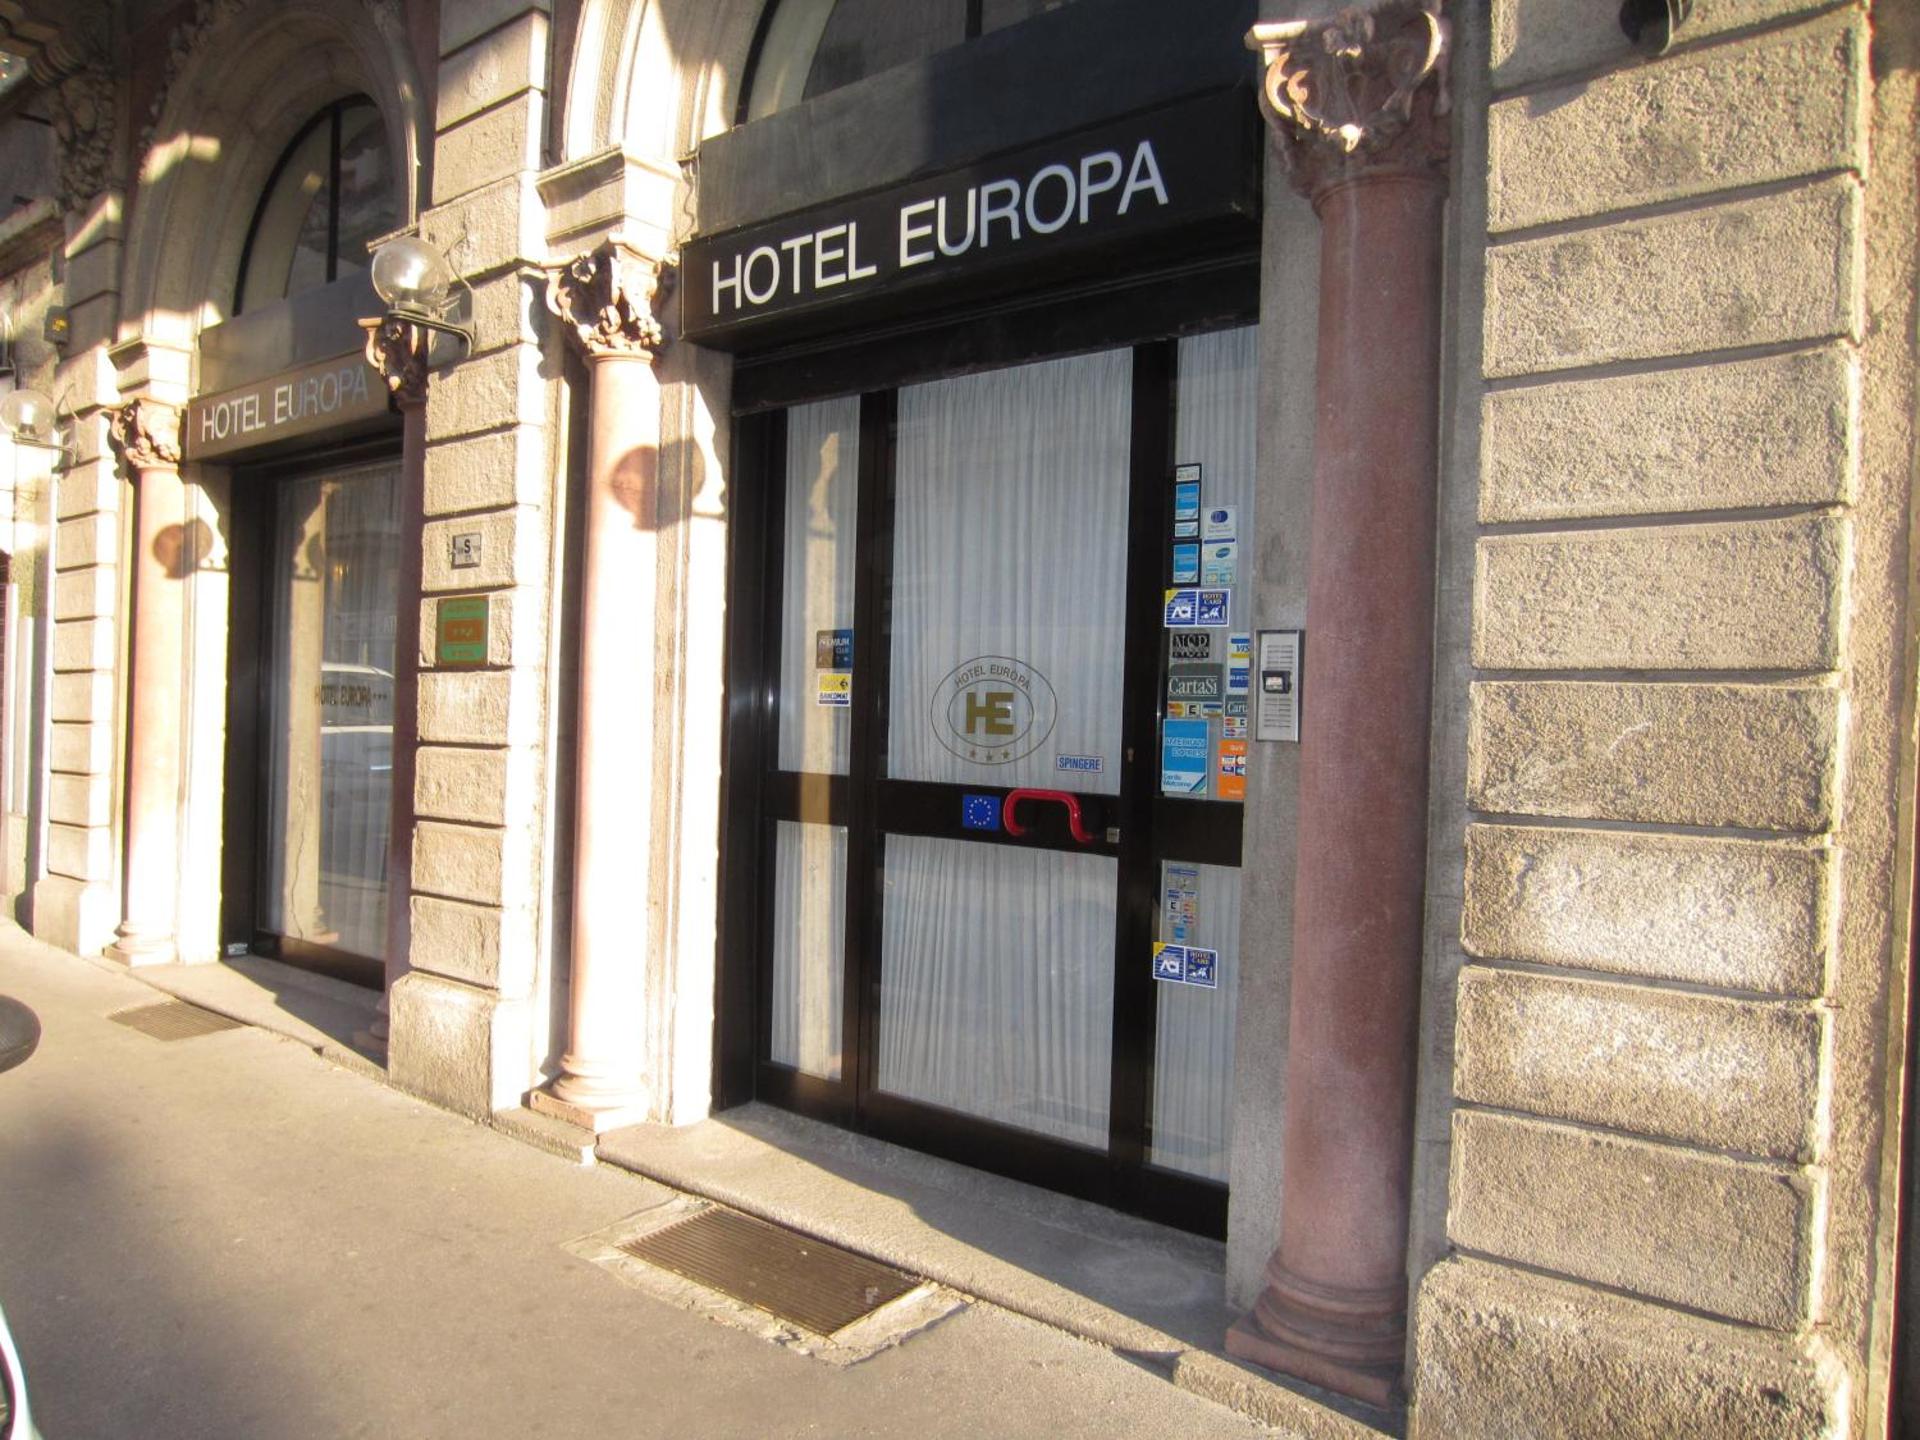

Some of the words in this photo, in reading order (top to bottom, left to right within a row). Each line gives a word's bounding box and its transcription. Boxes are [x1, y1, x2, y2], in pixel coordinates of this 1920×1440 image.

[712, 221, 877, 314] HOTEL
[899, 140, 1169, 268] EUROPA
[202, 394, 266, 442] HOTEL
[274, 365, 369, 424] EUROPA
[954, 665, 986, 688] HOTEL
[990, 664, 1031, 690] EUROPA
[966, 692, 1014, 735] HE
[1059, 757, 1101, 770] SPINGERE
